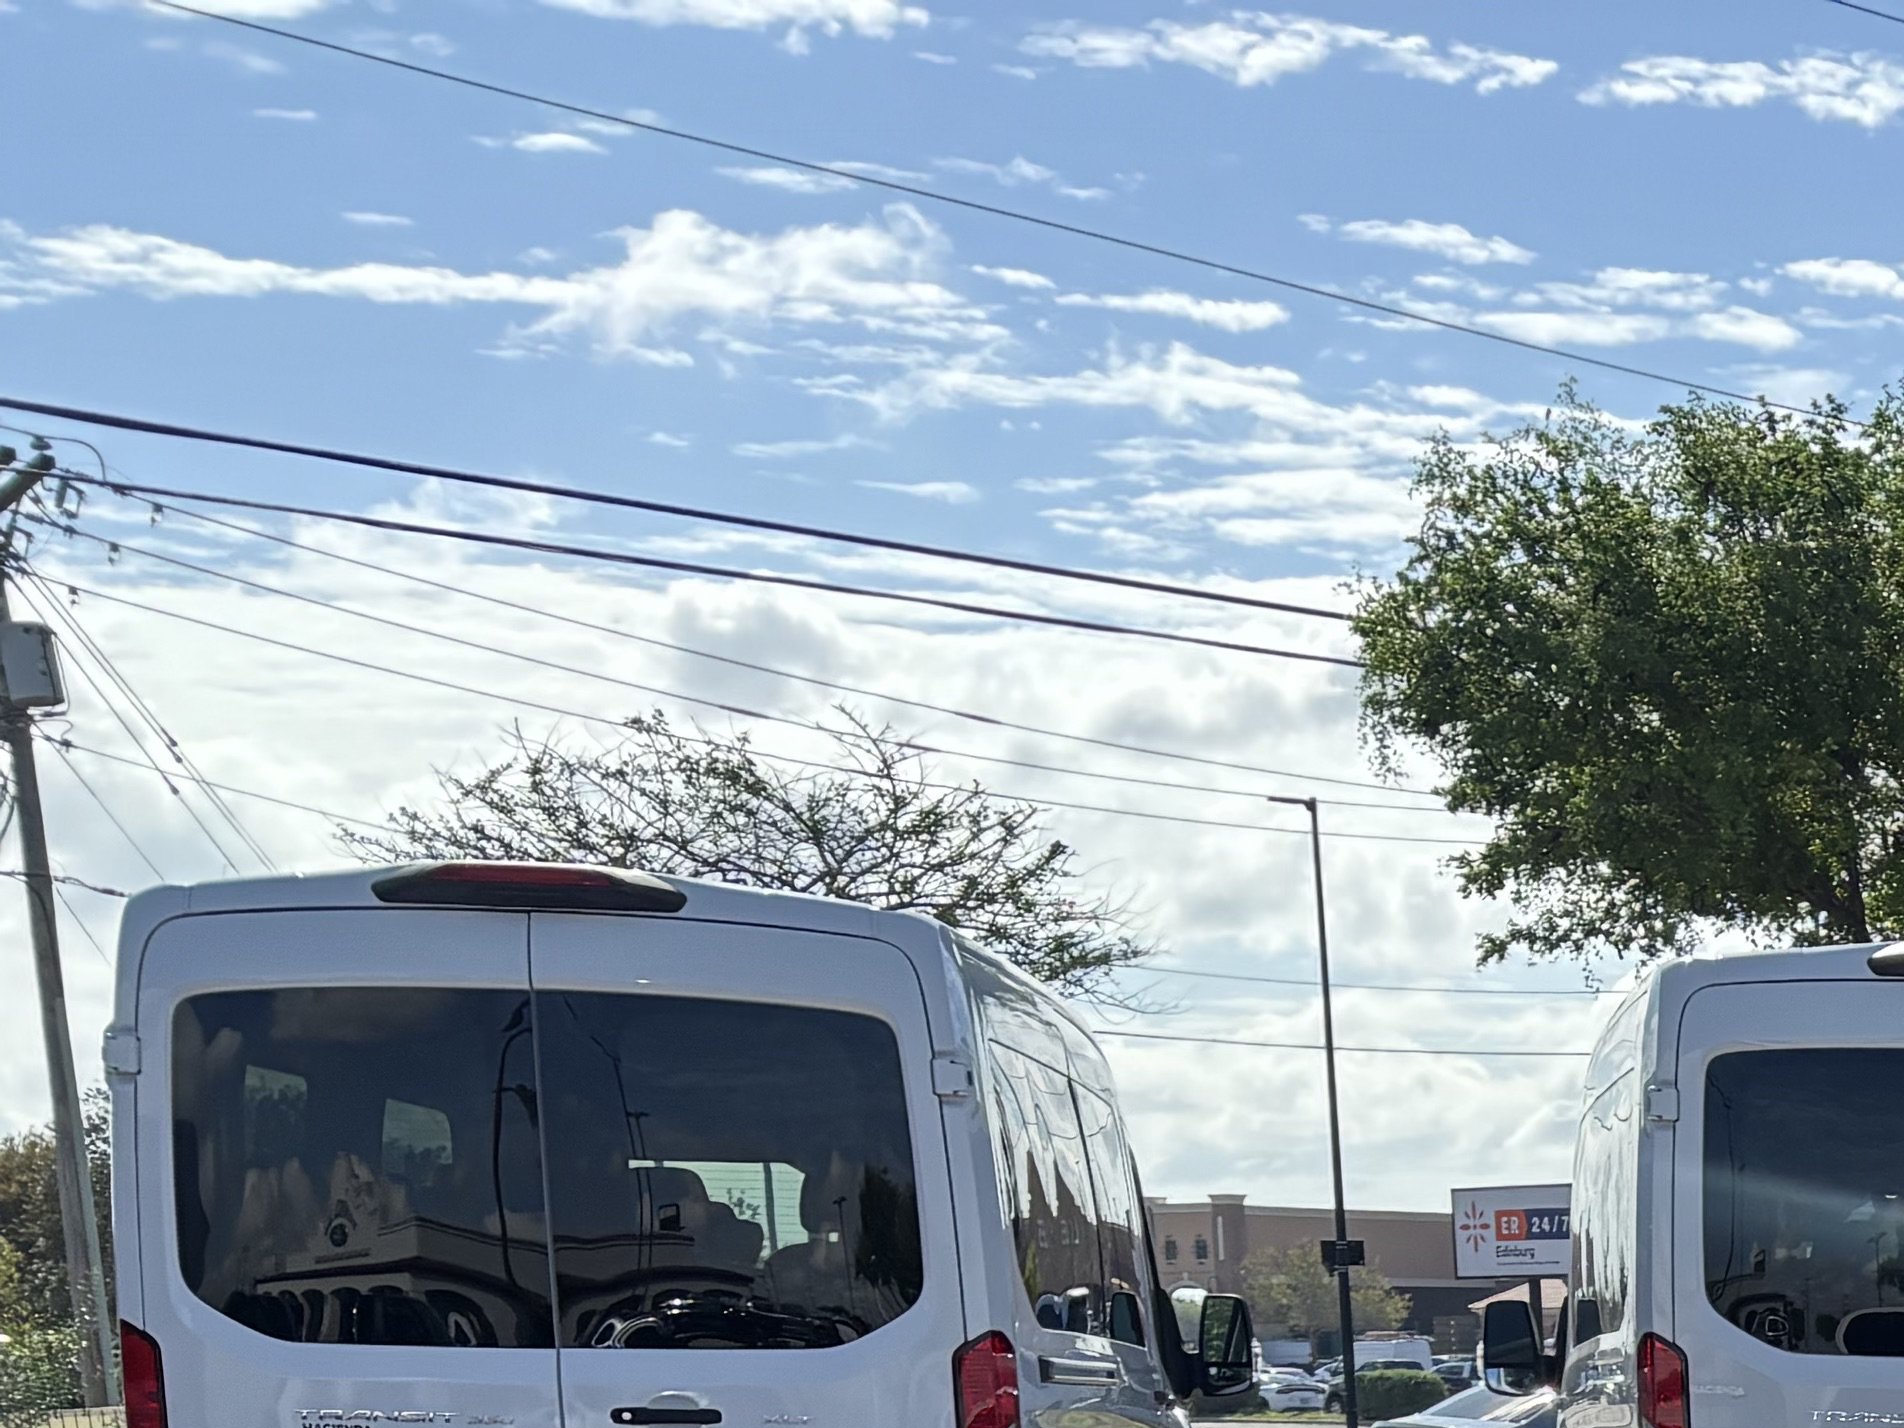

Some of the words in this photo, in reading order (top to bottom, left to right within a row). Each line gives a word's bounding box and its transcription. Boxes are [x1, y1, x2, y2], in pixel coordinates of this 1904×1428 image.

[1501, 1216, 1519, 1234] ER
[1531, 1215, 1569, 1233] 24/7
[294, 1409, 459, 1423] TRANSIT
